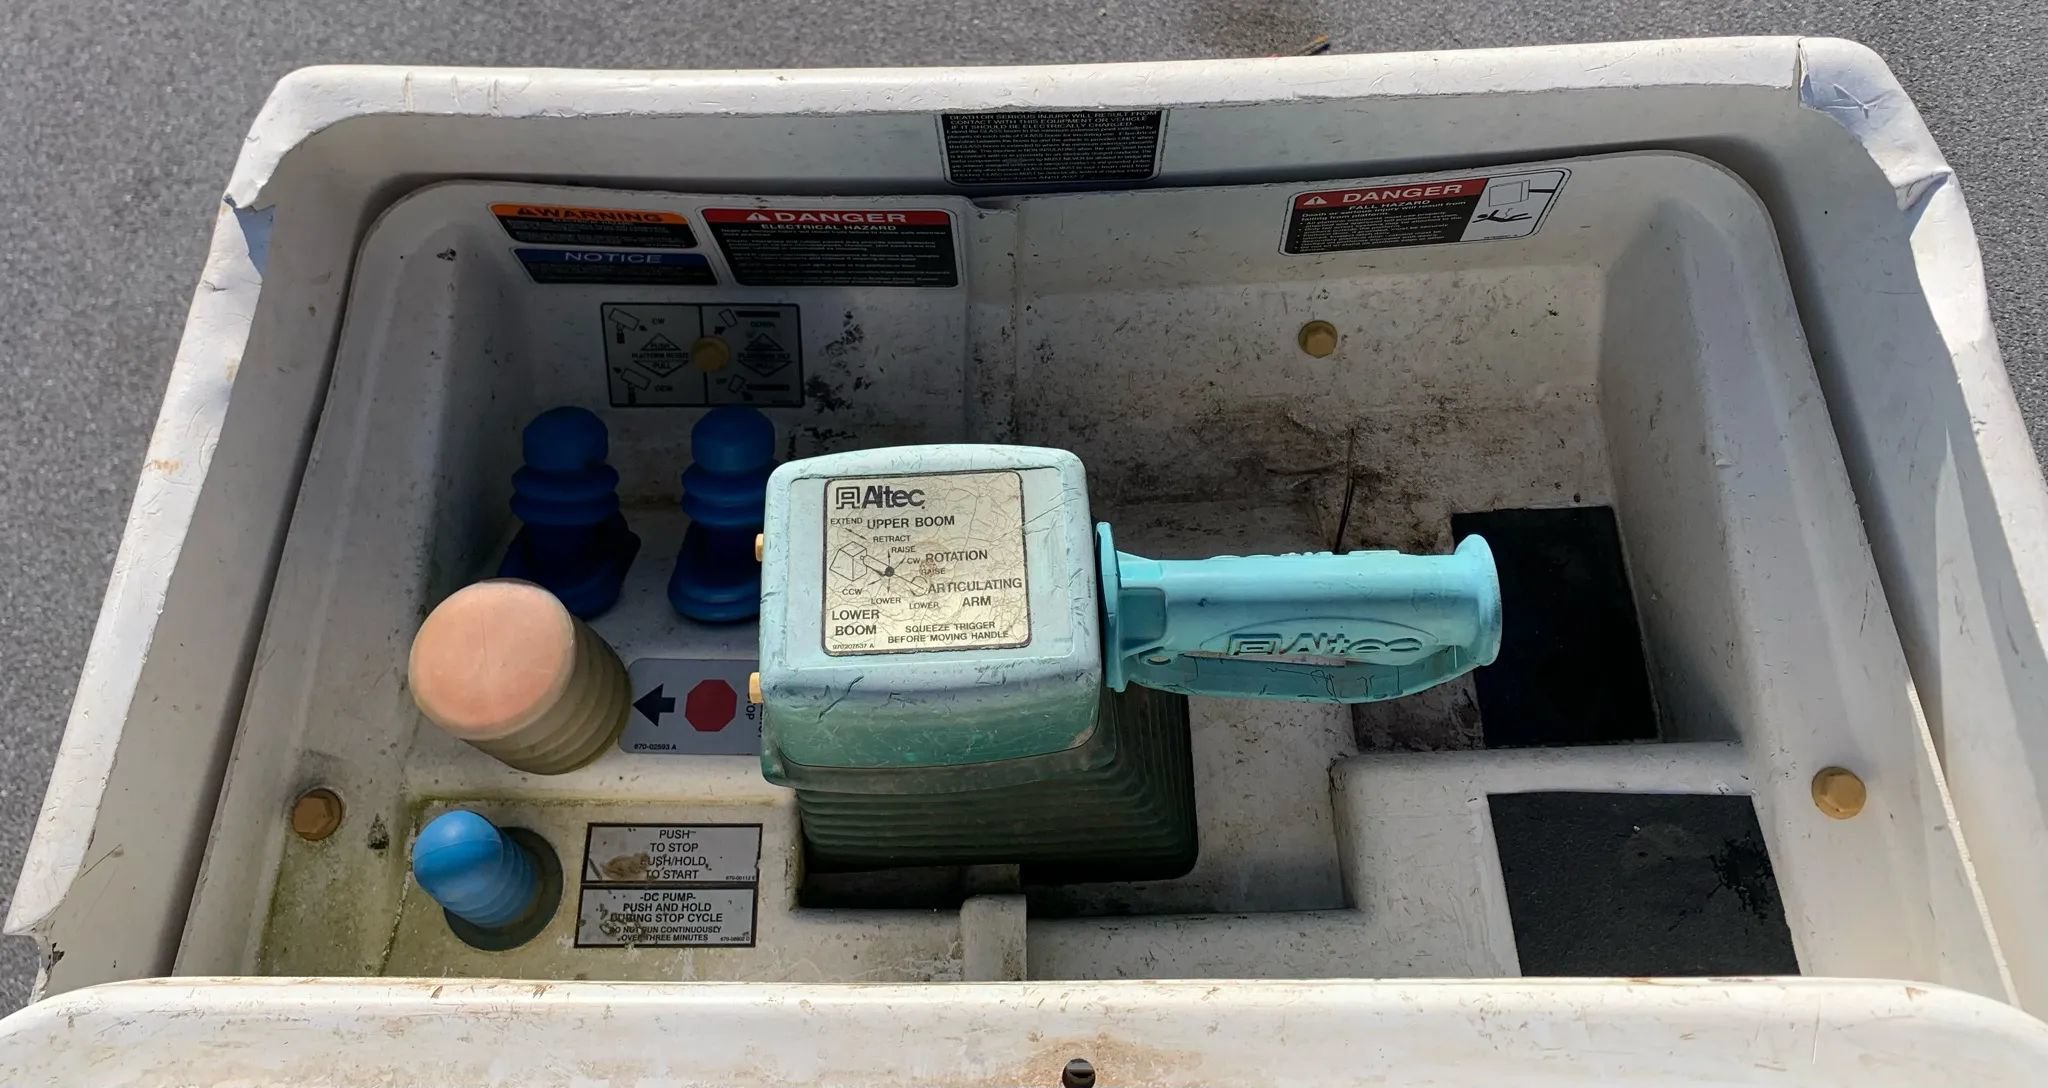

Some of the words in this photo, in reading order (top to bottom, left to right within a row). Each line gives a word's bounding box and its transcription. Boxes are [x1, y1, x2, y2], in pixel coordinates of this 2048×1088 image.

[1342, 184, 1463, 203] DANGER
[1381, 200, 1431, 208] HAZARD
[534, 208, 664, 222] WARNING
[775, 211, 907, 224] DANGER
[564, 252, 663, 265] NOTICE
[861, 485, 925, 510] Altec
[830, 517, 863, 525] EXTEND
[867, 517, 909, 529] UPPER
[915, 515, 955, 527] BOOM
[872, 535, 911, 543] RETRACT
[891, 545, 916, 553] RAISE
[925, 549, 988, 563] ROTATION
[928, 577, 1022, 594] ARTICULATING
[842, 588, 863, 596] CCW
[871, 597, 901, 605] LOWER
[909, 602, 939, 610] LOWER
[962, 596, 992, 607] ARM
[832, 609, 880, 621] LOWER
[835, 624, 877, 636] BOOM
[905, 623, 950, 634] SQUEEZE
[954, 621, 995, 631] TRIGGER
[887, 634, 926, 644] BEFORE
[930, 632, 967, 641] MOVING
[971, 630, 1009, 639] HANDLE
[659, 829, 690, 839] PUSH
[650, 843, 665, 852] TO
[668, 843, 698, 852] STOP
[646, 870, 660, 879] TO
[662, 869, 699, 879] START
[640, 893, 660, 902] -DC
[662, 893, 696, 902] PUMP-
[622, 903, 652, 912] PUSH
[655, 903, 678, 912] AND
[681, 903, 711, 912] HOLD
[655, 913, 684, 922] STOP
[687, 913, 723, 922] CYCLE
[660, 926, 721, 934] CONTINUOUSLY
